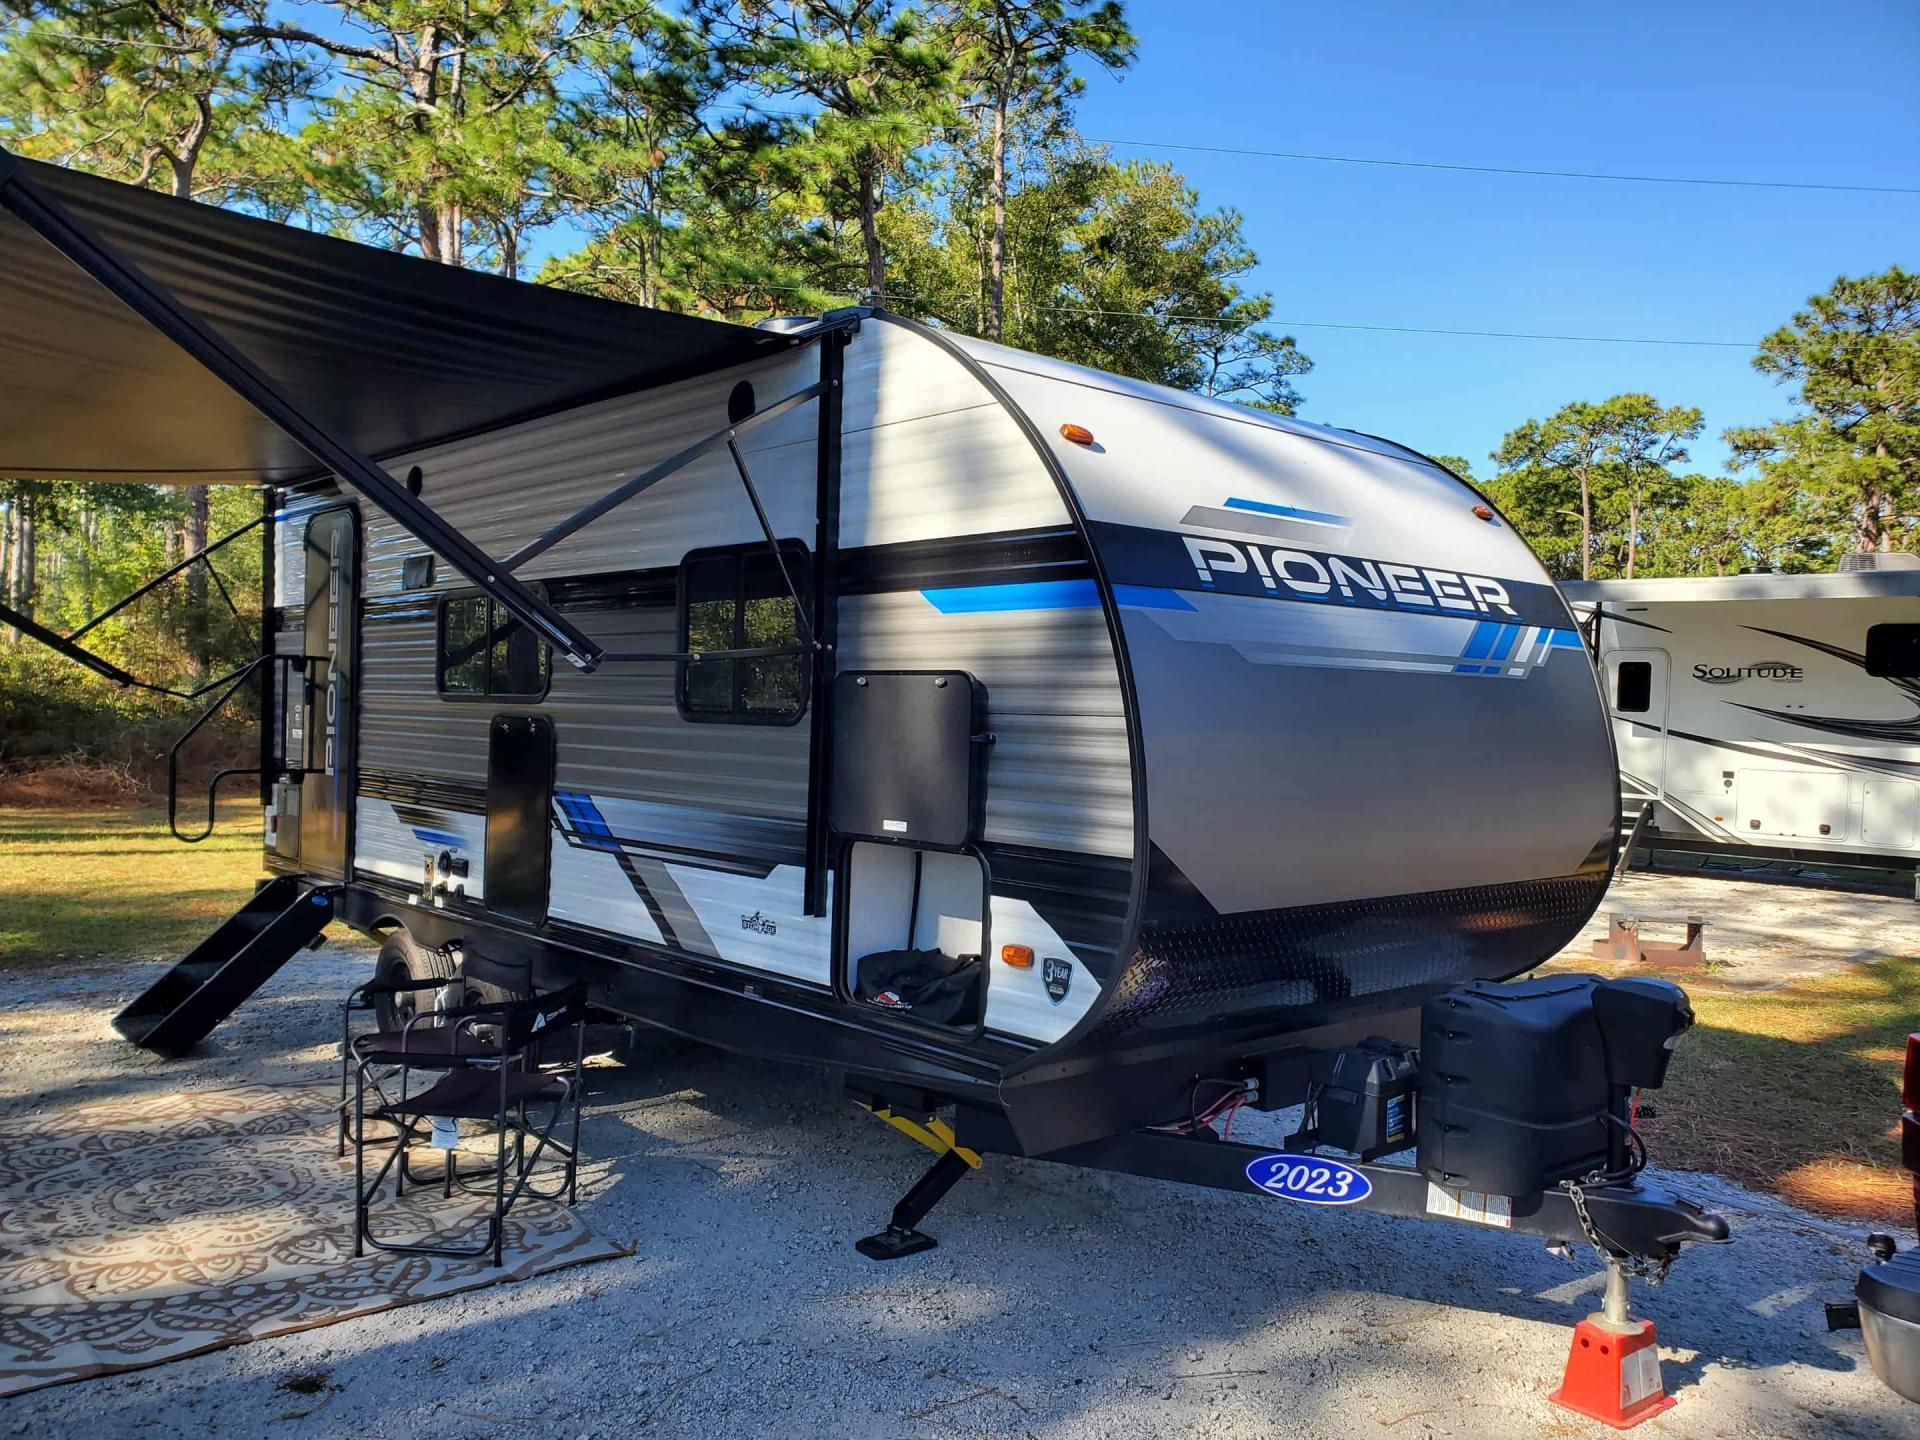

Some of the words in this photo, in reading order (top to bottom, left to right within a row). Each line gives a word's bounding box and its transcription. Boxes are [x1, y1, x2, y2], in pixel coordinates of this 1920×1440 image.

[1181, 536, 1520, 616] PIONEER
[325, 528, 341, 777] PIONEER
[1692, 663, 1804, 680] SOLITUDE
[1045, 960, 1055, 982] 3
[1054, 964, 1069, 980] YEAR
[1263, 1162, 1354, 1197] 2023
